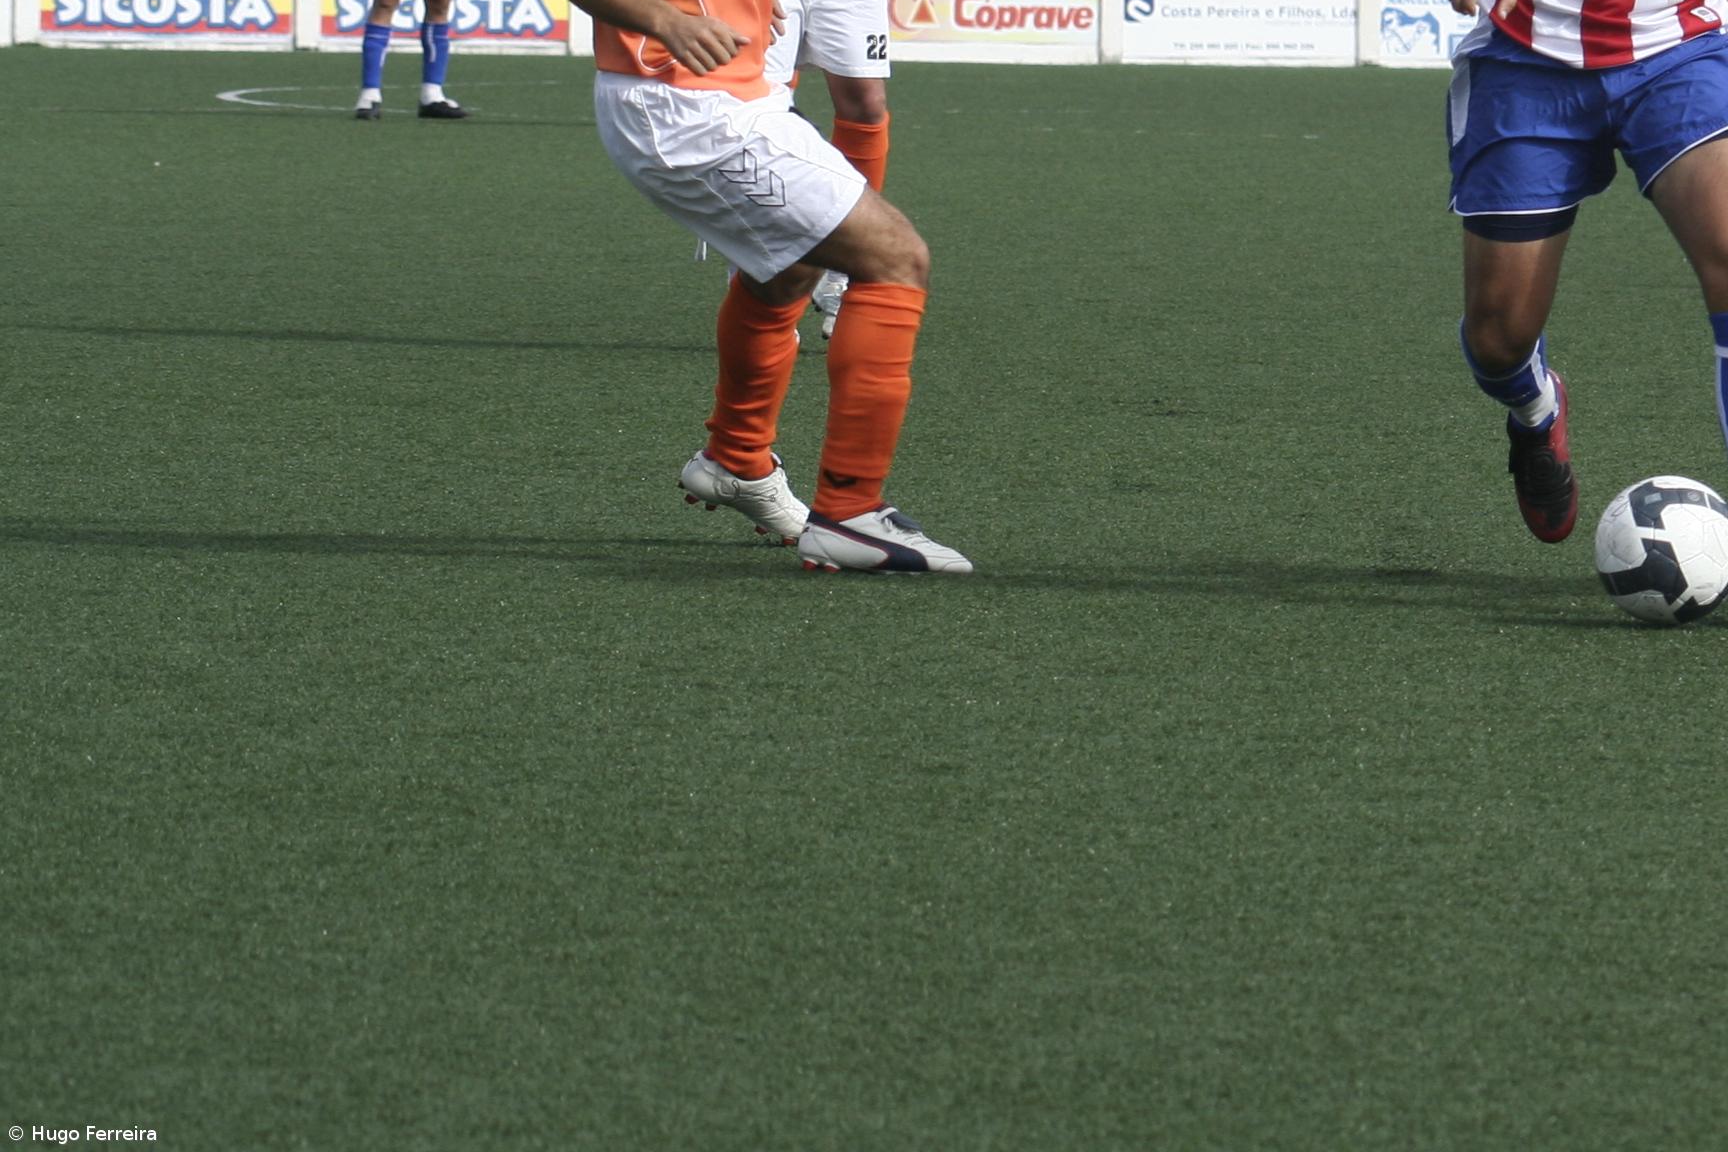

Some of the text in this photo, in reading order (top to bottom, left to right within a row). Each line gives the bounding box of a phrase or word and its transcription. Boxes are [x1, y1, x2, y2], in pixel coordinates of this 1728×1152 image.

[1161, 6, 1202, 18] Costa
[1207, 6, 1260, 18] Pereira
[1265, 8, 1274, 18] e
[866, 34, 887, 60] 22
